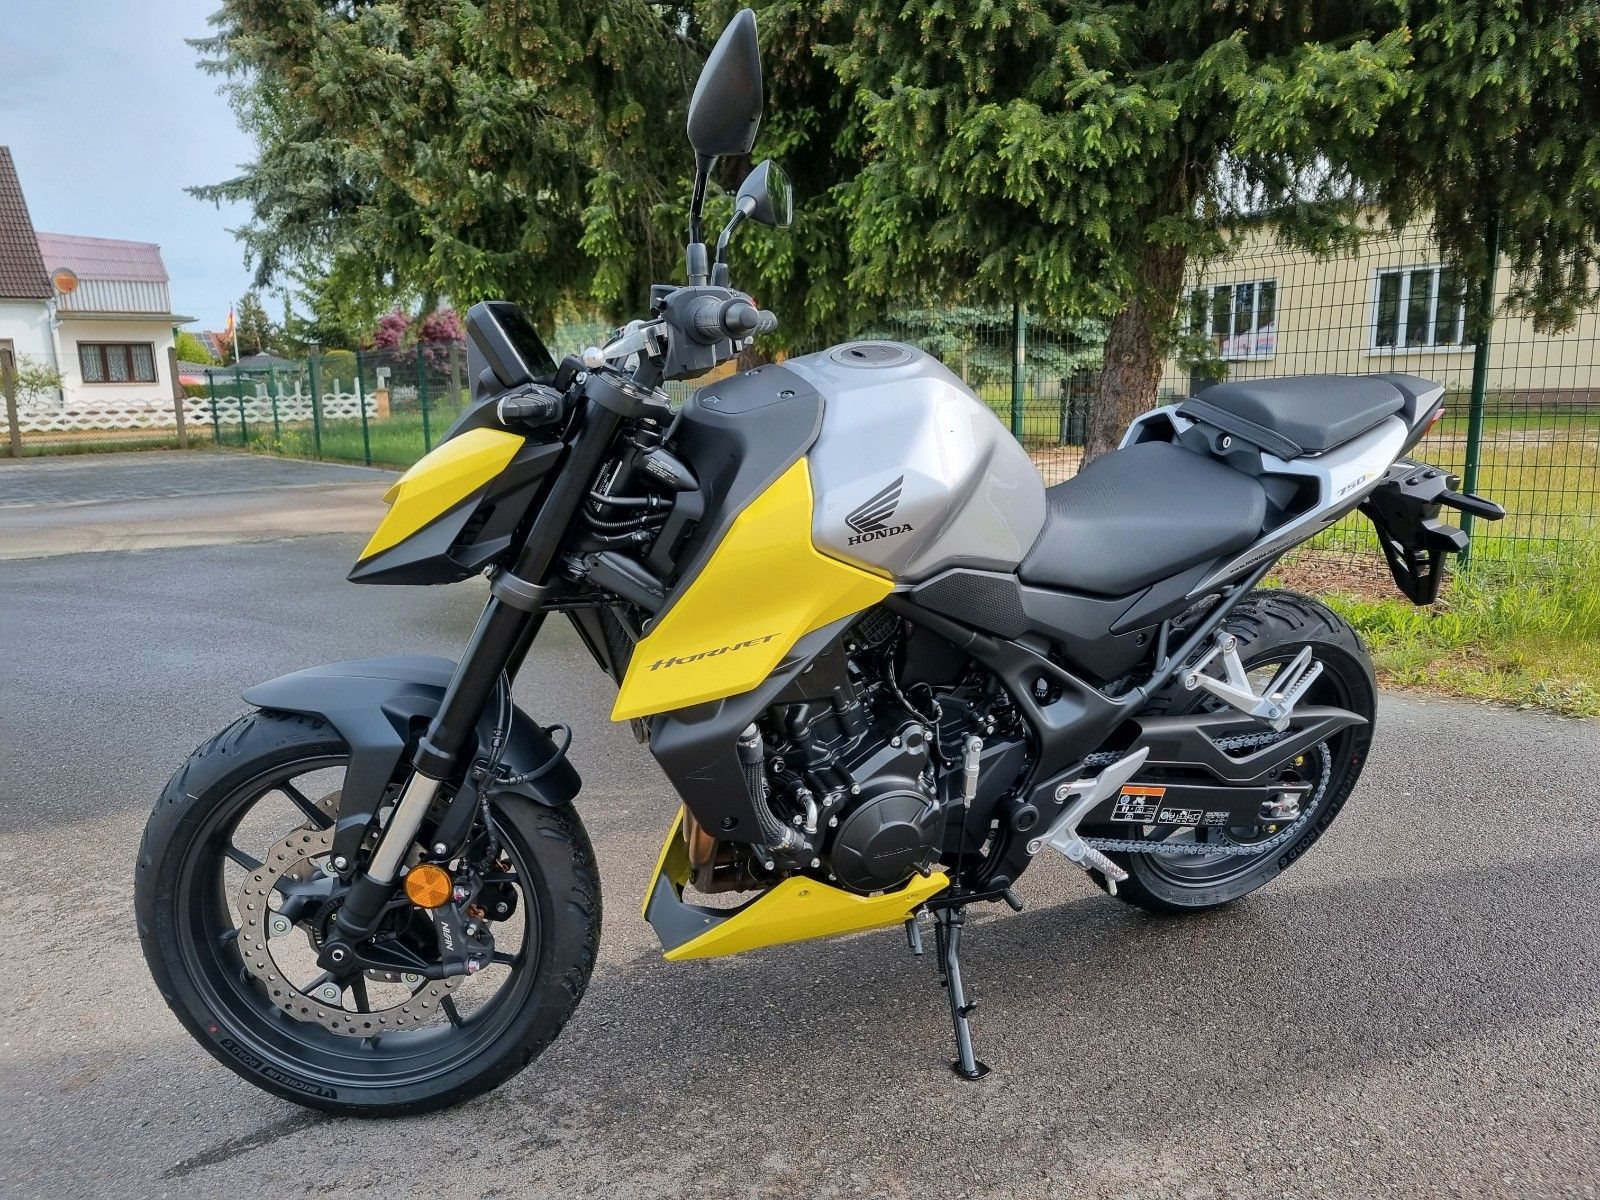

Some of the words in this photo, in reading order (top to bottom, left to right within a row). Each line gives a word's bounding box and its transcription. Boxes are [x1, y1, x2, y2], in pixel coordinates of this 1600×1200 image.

[1336, 474, 1367, 497] 750
[847, 523, 914, 546] HONDA
[644, 632, 782, 672] HORNET
[1290, 834, 1316, 859] ROAD
[1279, 857, 1288, 867] 6
[223, 1040, 233, 1048] 6
[232, 1046, 259, 1067] ROAD
[265, 1067, 318, 1094] MICHELIN
